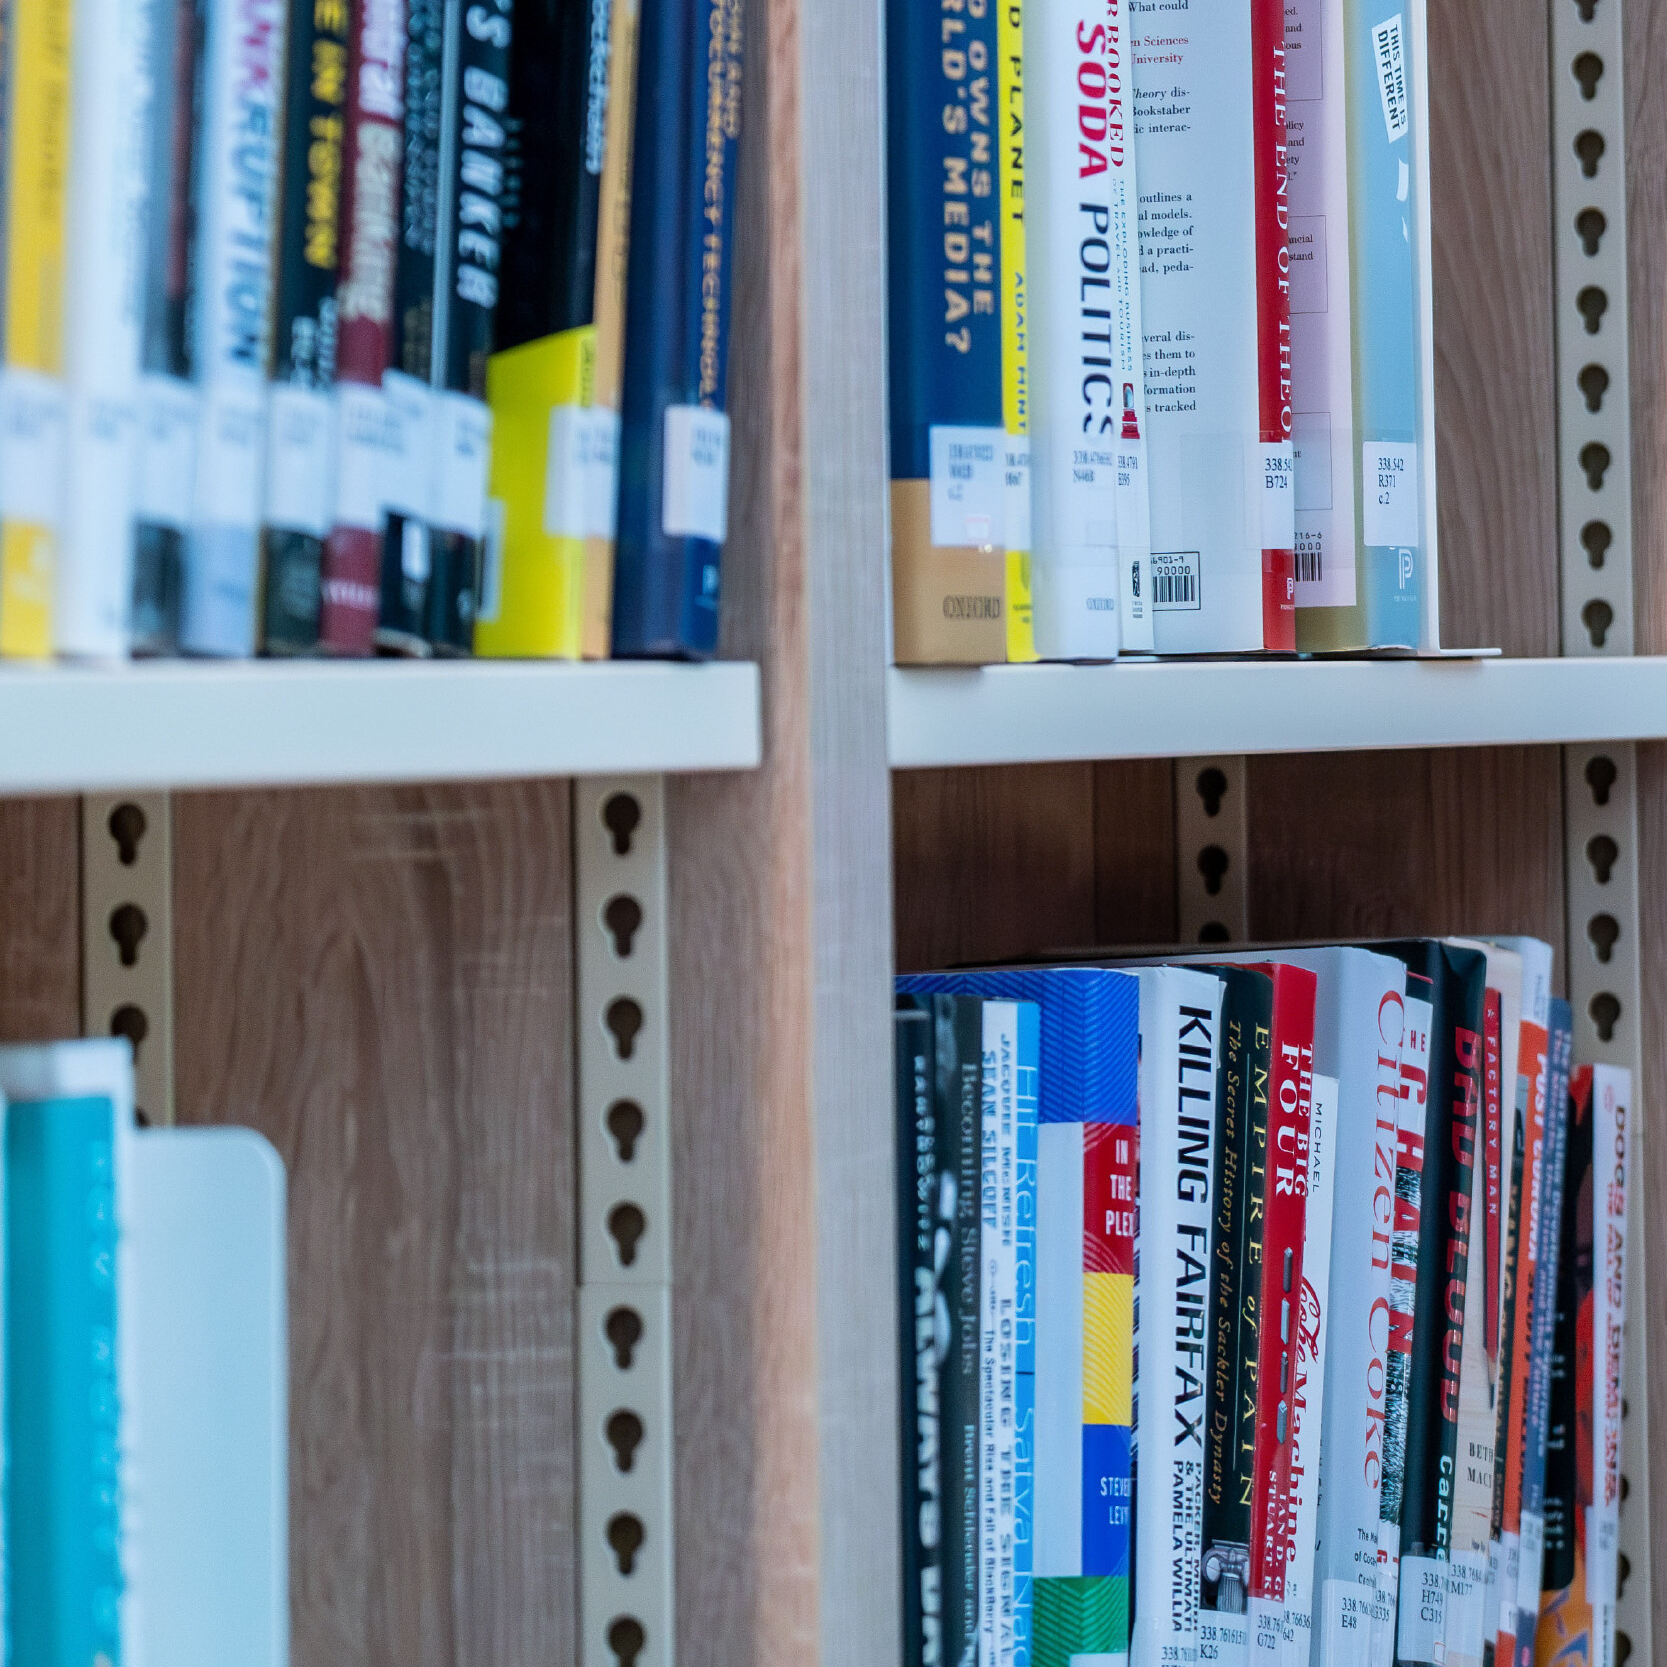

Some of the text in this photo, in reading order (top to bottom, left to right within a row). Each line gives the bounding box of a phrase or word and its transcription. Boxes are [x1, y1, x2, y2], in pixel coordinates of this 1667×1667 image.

[1128, 0, 1156, 14] What
[1143, 35, 1190, 48] Sciences
[310, 38, 347, 106] IN
[1074, 18, 1110, 180] SODA
[1170, 86, 1191, 99] dis-
[1377, 31, 1402, 131] DIFFERENT
[1388, 22, 1405, 104] THIS TIME
[968, 38, 992, 199] OWNS
[1008, 54, 1026, 227] PLANET
[1148, 122, 1192, 135] interac-
[1287, 136, 1305, 147] and
[303, 113, 344, 270] TOWN
[456, 64, 510, 311] BANKER
[1139, 191, 1183, 204] outlines
[1150, 207, 1193, 221] models.
[1273, 40, 1290, 305] THE END OF
[942, 156, 972, 355] MEDIA?
[972, 219, 995, 316] THE
[1156, 243, 1195, 259] practi-
[1162, 260, 1195, 276] peda-
[1013, 270, 1028, 353] ADAM
[1078, 201, 1114, 436] POLITICS
[1149, 365, 1197, 380] in-depth
[1154, 348, 1182, 361] them
[1154, 399, 1197, 413] tracked
[1264, 474, 1288, 490] B724
[1377, 457, 1405, 472] 338.542
[1377, 474, 1397, 489] R371
[1378, 491, 1391, 506] c.2
[942, 594, 1001, 620] OXFORD
[1156, 565, 1191, 576] 90000
[982, 1049, 998, 1229] SEAN SILCOFF
[1115, 1138, 1129, 1165] IN
[1275, 1040, 1300, 1198] FOUR
[1294, 1042, 1314, 1199] THE BIG
[1312, 1101, 1323, 1195] MICHAEL
[1485, 1034, 1498, 1215] FACTORY MAN
[1014, 1065, 1038, 1345] Hit Refresh
[1109, 1173, 1132, 1202] THE
[1173, 1004, 1213, 1449] KILLING FAIRFAX
[1439, 1025, 1483, 1425] BAD BLOOD
[1209, 1019, 1242, 1505] The Secret History the Sackler Dynasty
[1238, 1021, 1270, 1507] EMPIRE PAIN
[1363, 986, 1404, 1491] Citizen Coke
[983, 1355, 996, 1634] Spectacular BlackBerry
[1001, 1298, 1014, 1654] LOSING SIGNAL
[1013, 1407, 1035, 1544] Satya
[1172, 1459, 1184, 1552] PAMELA
[1184, 1481, 1194, 1522] THE
[1285, 1368, 1309, 1564] Machine
[1264, 1469, 1277, 1568] STUART
[1357, 1527, 1370, 1541] The
[1199, 1643, 1219, 1660] K26
[1341, 1613, 1357, 1630] E48
[1420, 1606, 1443, 1625] C315
